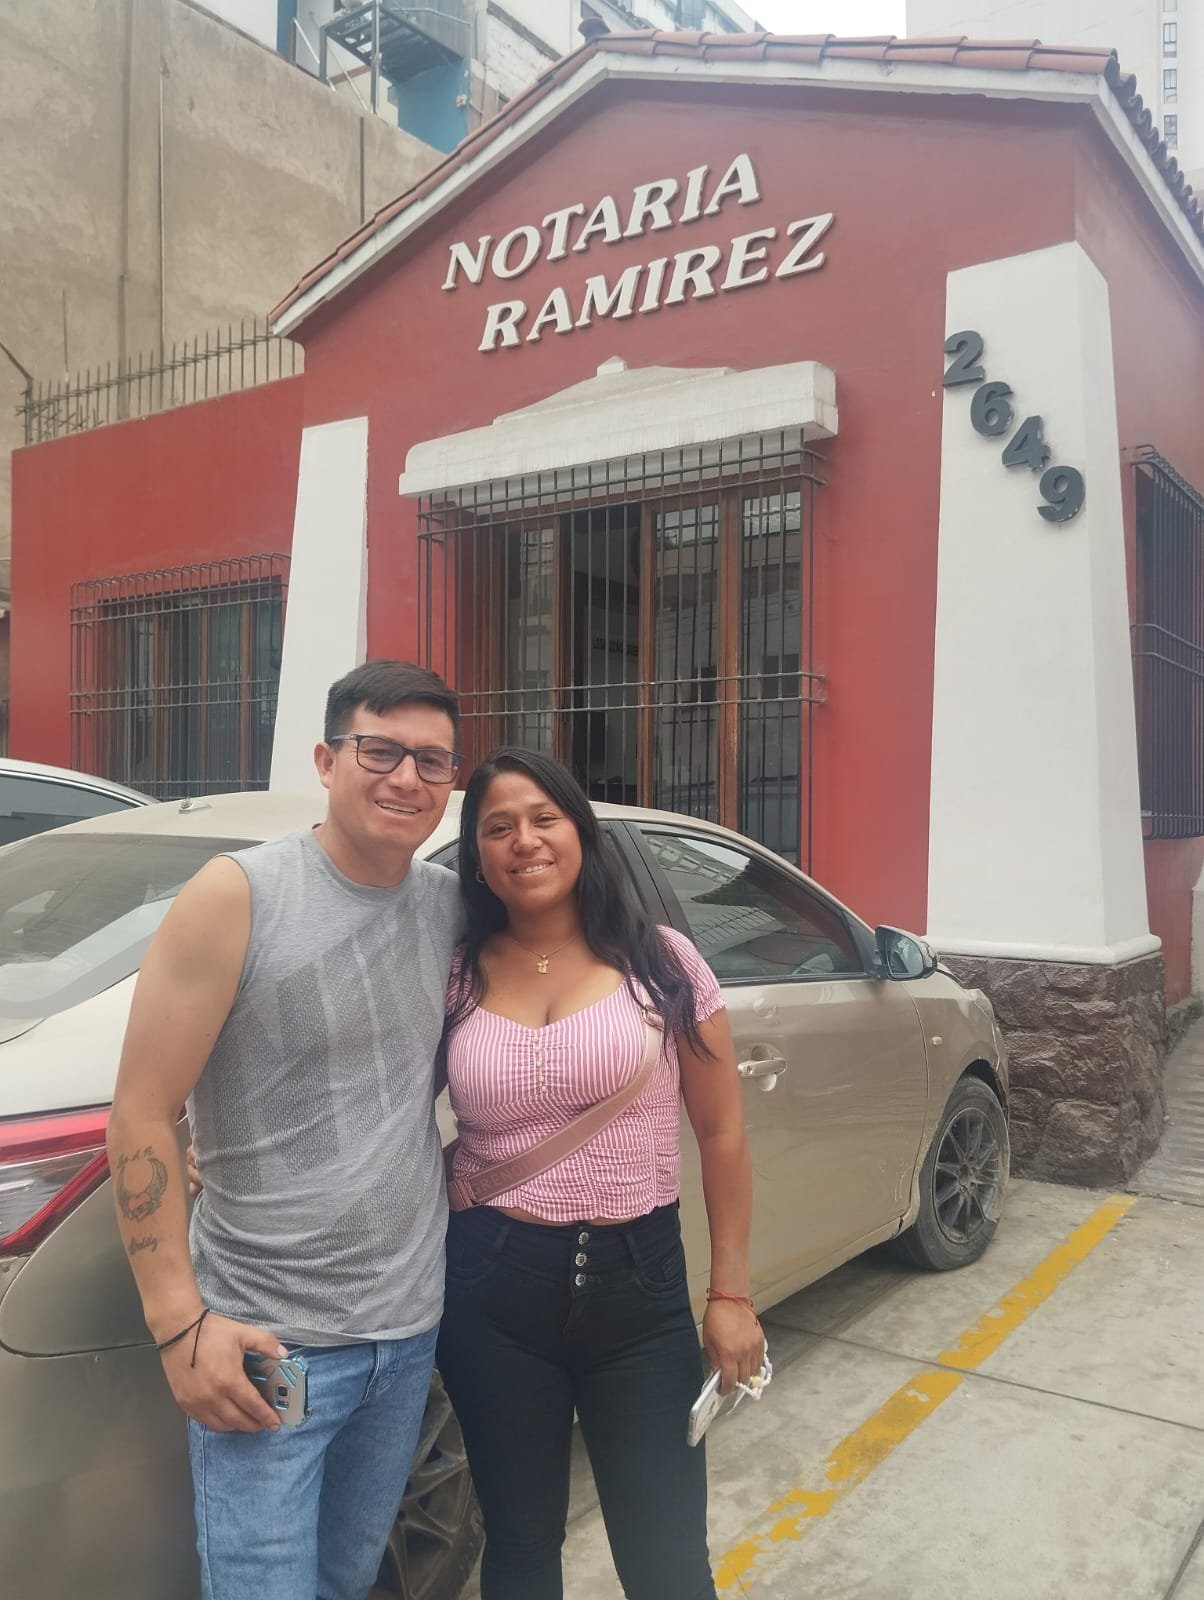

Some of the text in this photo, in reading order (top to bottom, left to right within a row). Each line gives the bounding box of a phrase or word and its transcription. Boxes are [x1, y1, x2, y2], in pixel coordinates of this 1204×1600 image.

[441, 153, 761, 290] NOTARIA
[478, 212, 835, 351] RAMIREZ
[942, 330, 1086, 523] 2649
